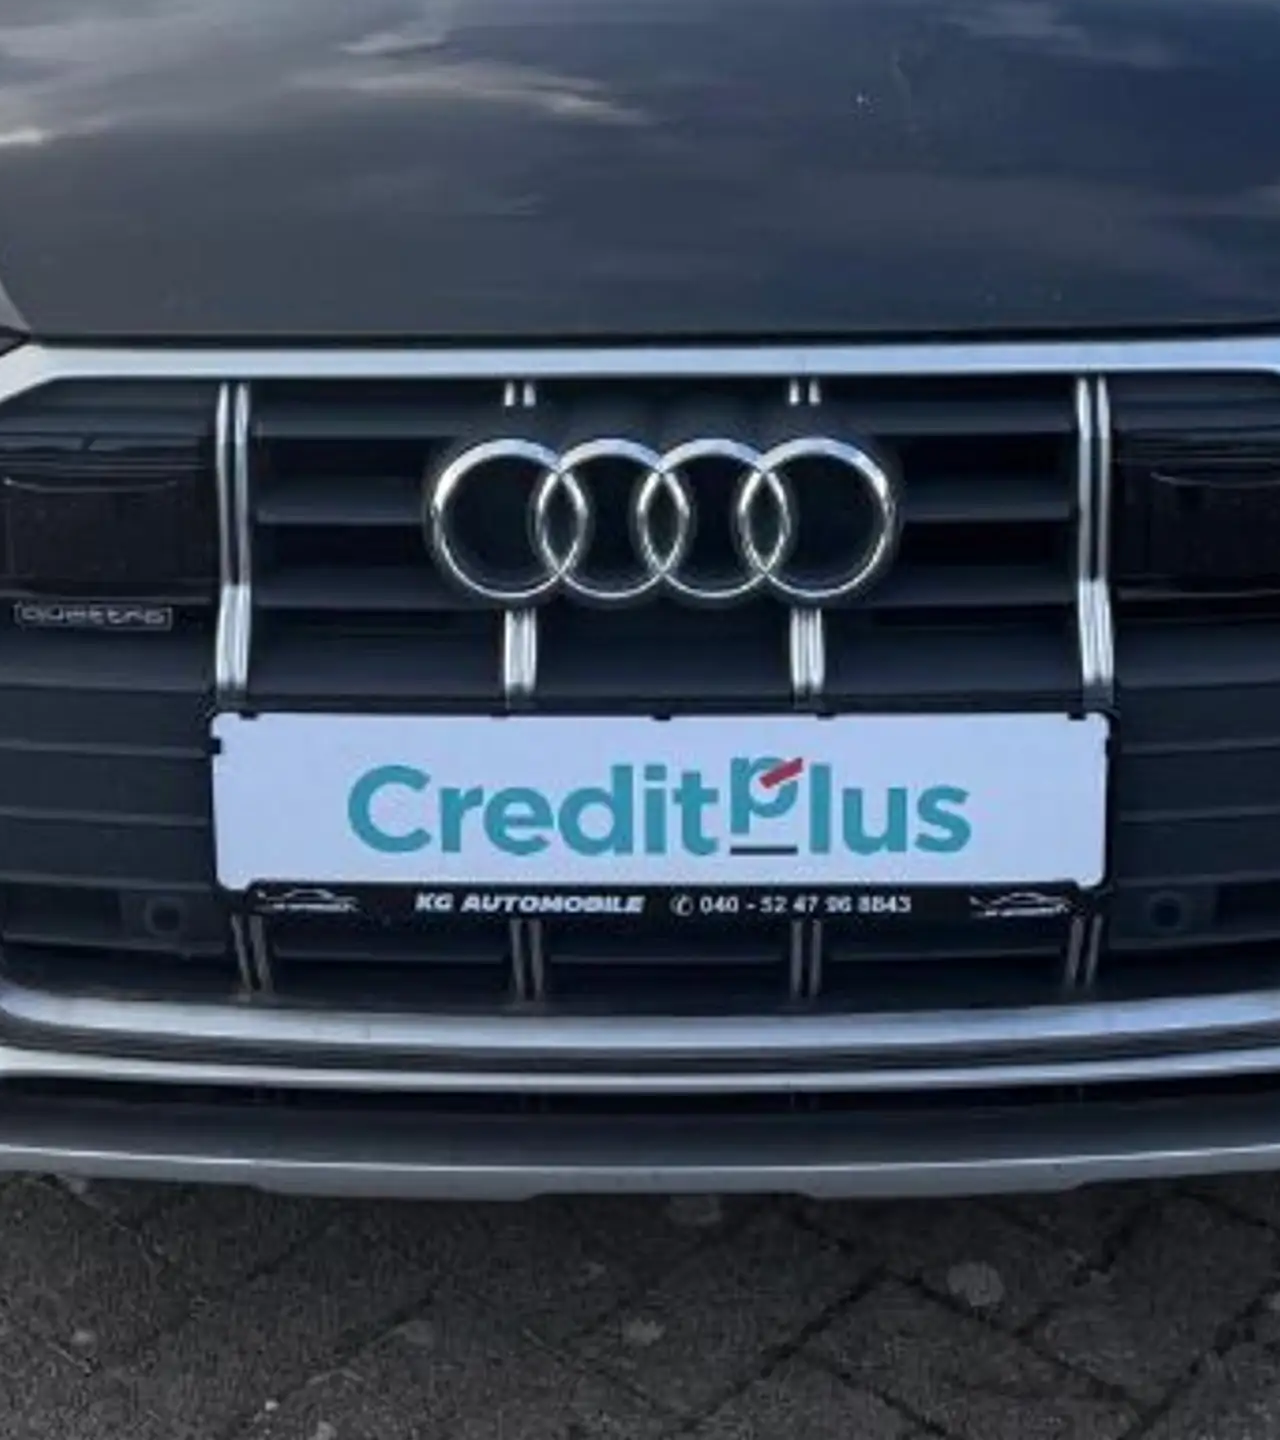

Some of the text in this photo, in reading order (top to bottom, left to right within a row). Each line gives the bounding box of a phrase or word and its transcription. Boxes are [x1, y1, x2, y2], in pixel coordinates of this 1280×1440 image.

[347, 757, 972, 856] CreditPlus
[415, 893, 452, 911] KG
[461, 895, 644, 913] AUTOMOBILE
[700, 896, 739, 913] 040
[760, 896, 786, 913] 52
[793, 896, 819, 913] 47
